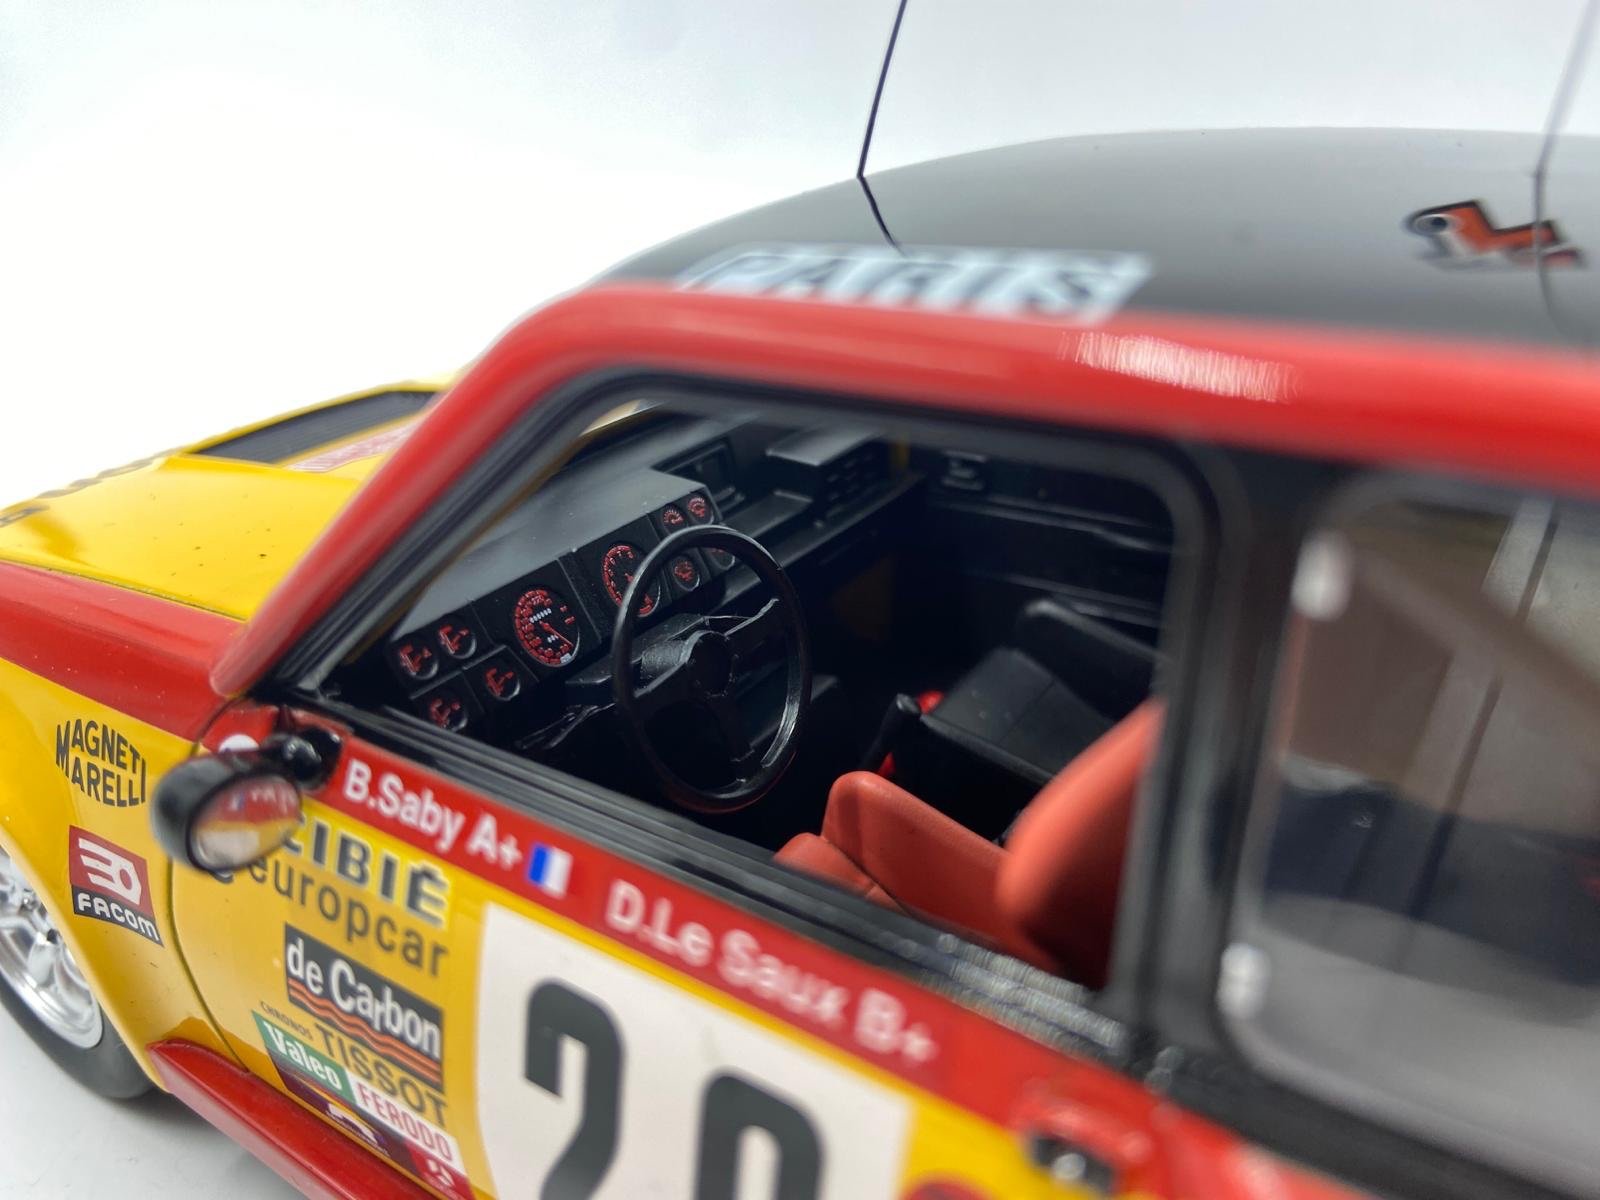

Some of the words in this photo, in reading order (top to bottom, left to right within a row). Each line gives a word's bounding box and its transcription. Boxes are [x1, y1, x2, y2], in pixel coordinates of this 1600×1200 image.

[56, 719, 146, 790] MAGNETI
[56, 740, 146, 807] MARELLI
[342, 757, 465, 853] B.Saby
[465, 818, 523, 872] A+
[287, 938, 323, 995] de
[330, 958, 441, 1061] Carbon
[605, 878, 712, 968] D.Le
[719, 927, 850, 1031] Saux
[853, 985, 940, 1062] B+
[263, 1020, 343, 1091] Valeo
[315, 1022, 447, 1126] TISSOT
[357, 1081, 453, 1162] FERODO
